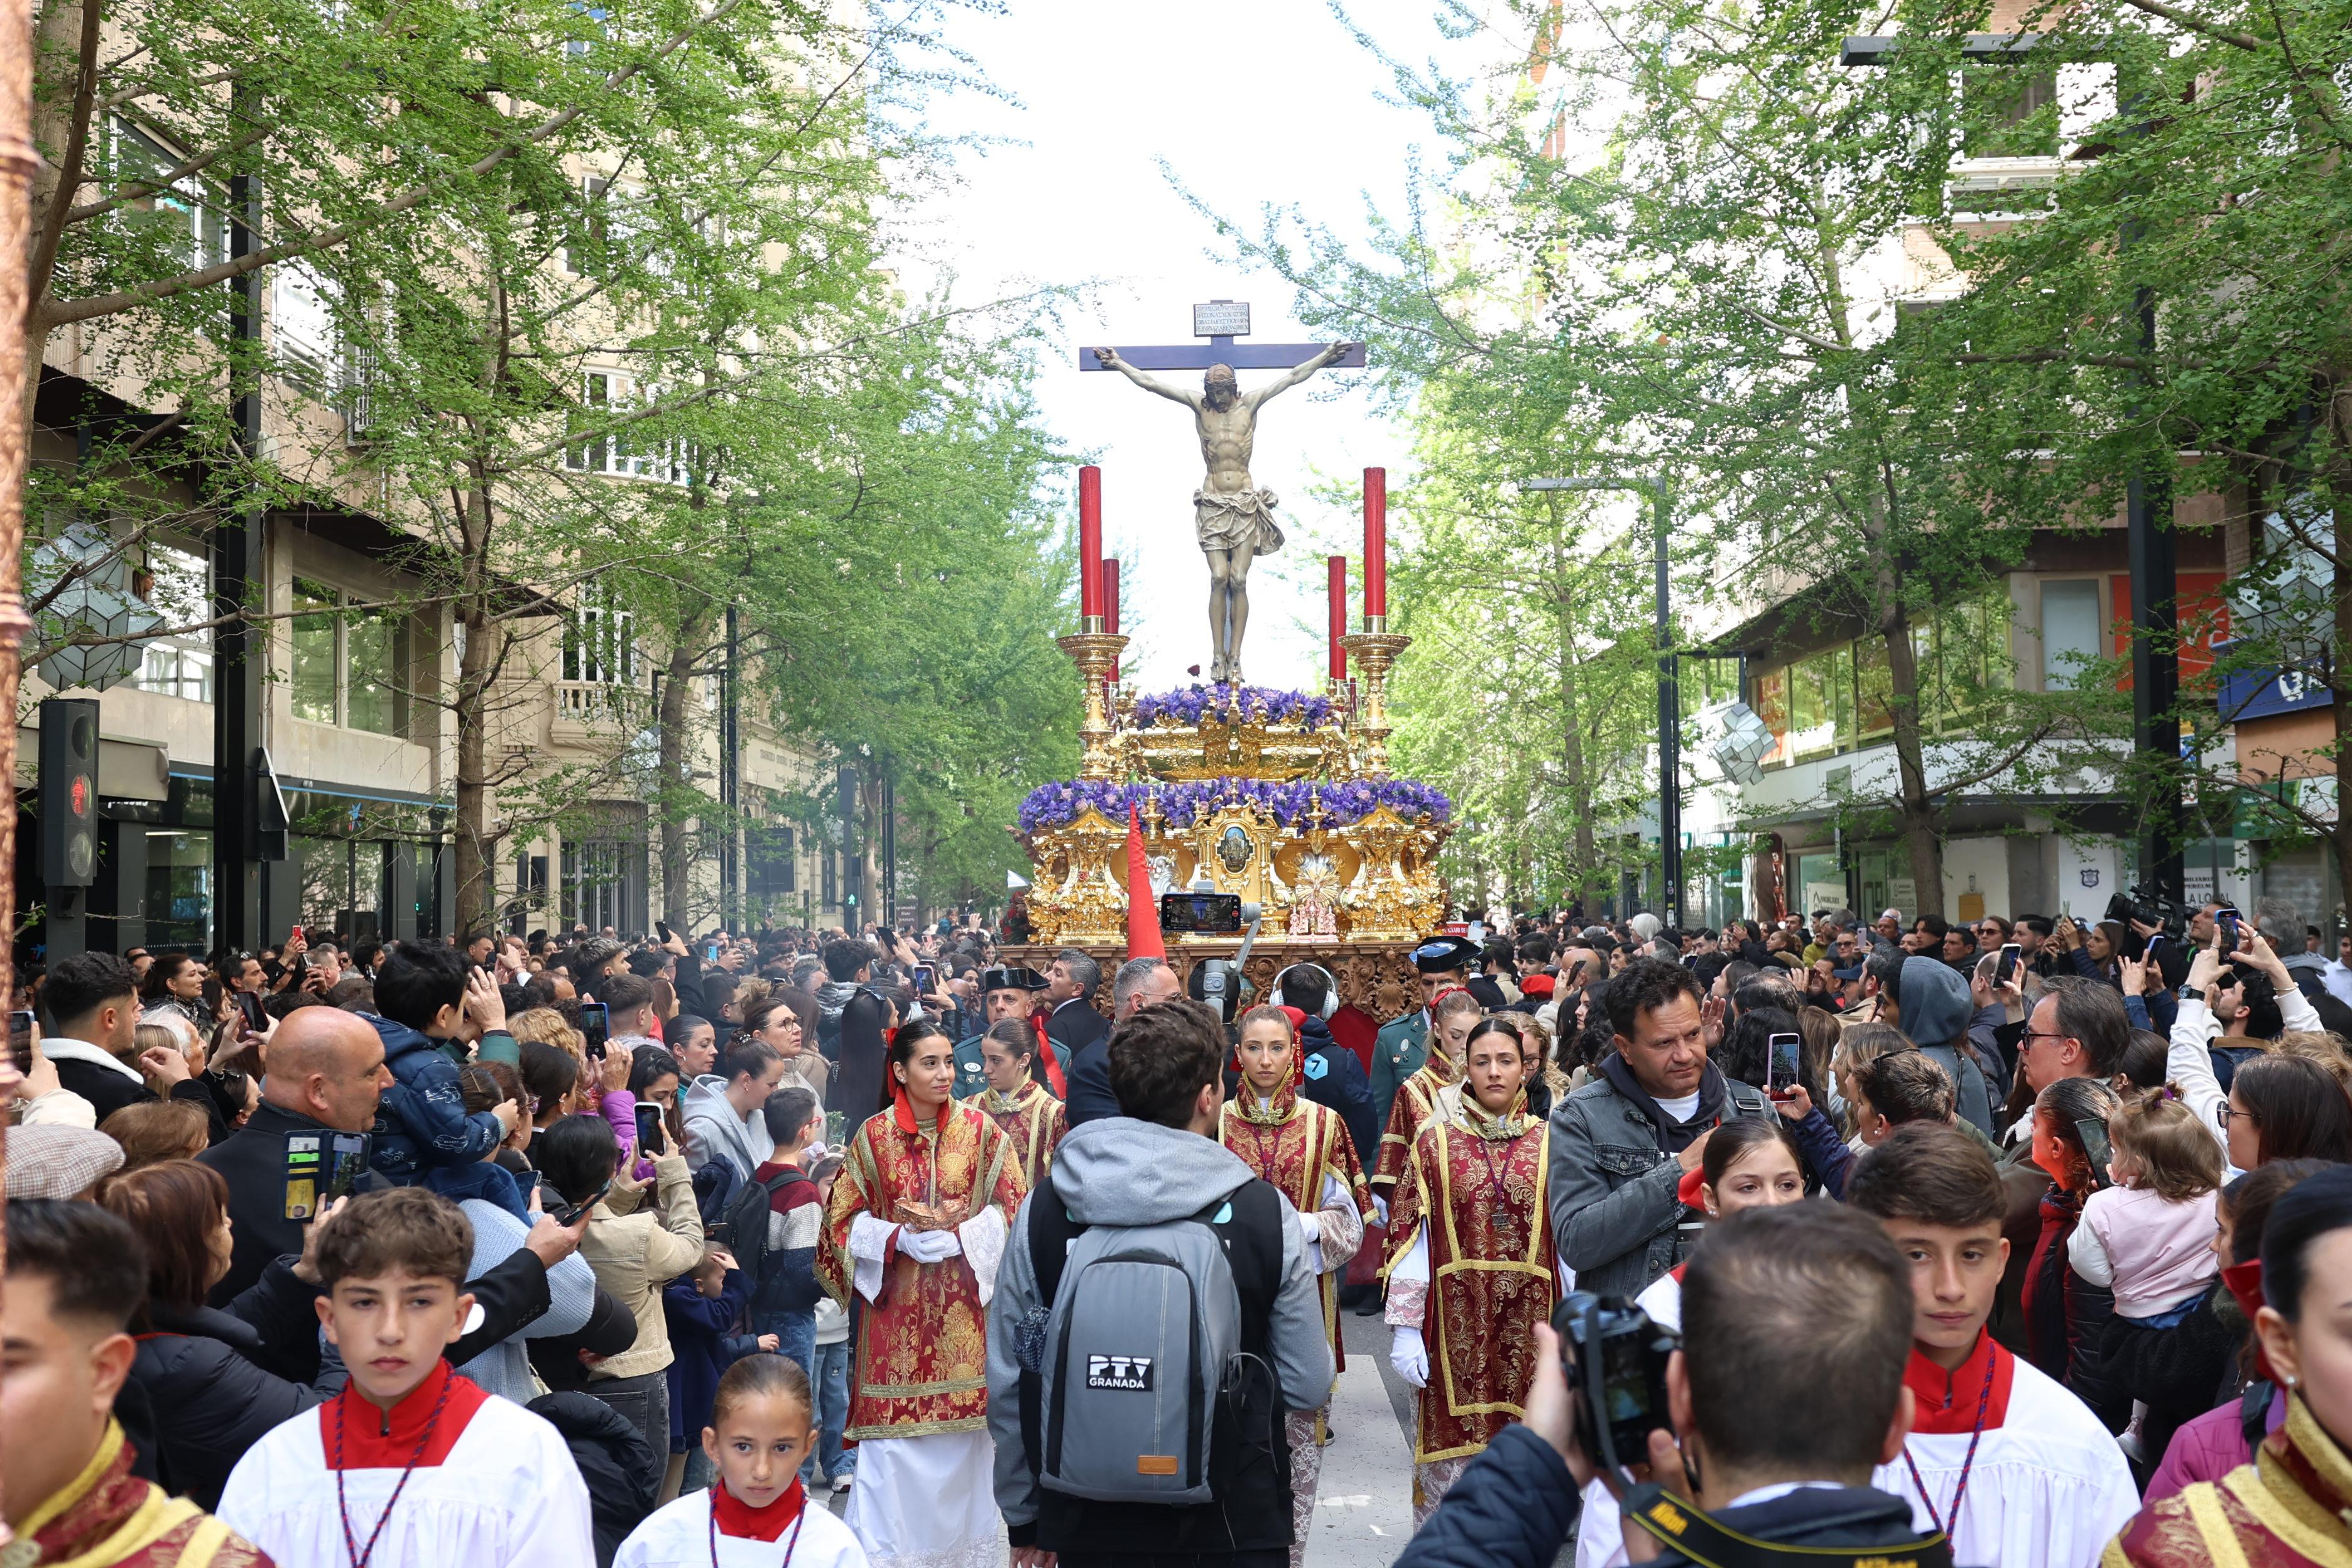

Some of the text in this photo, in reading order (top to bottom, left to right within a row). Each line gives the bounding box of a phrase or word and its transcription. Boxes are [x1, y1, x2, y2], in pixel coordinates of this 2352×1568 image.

[2199, 893, 2232, 905] LOAL
[1312, 1060, 1320, 1072] 7
[1089, 1355, 1152, 1378] PTV
[1089, 1377, 1145, 1389] GRANADA
